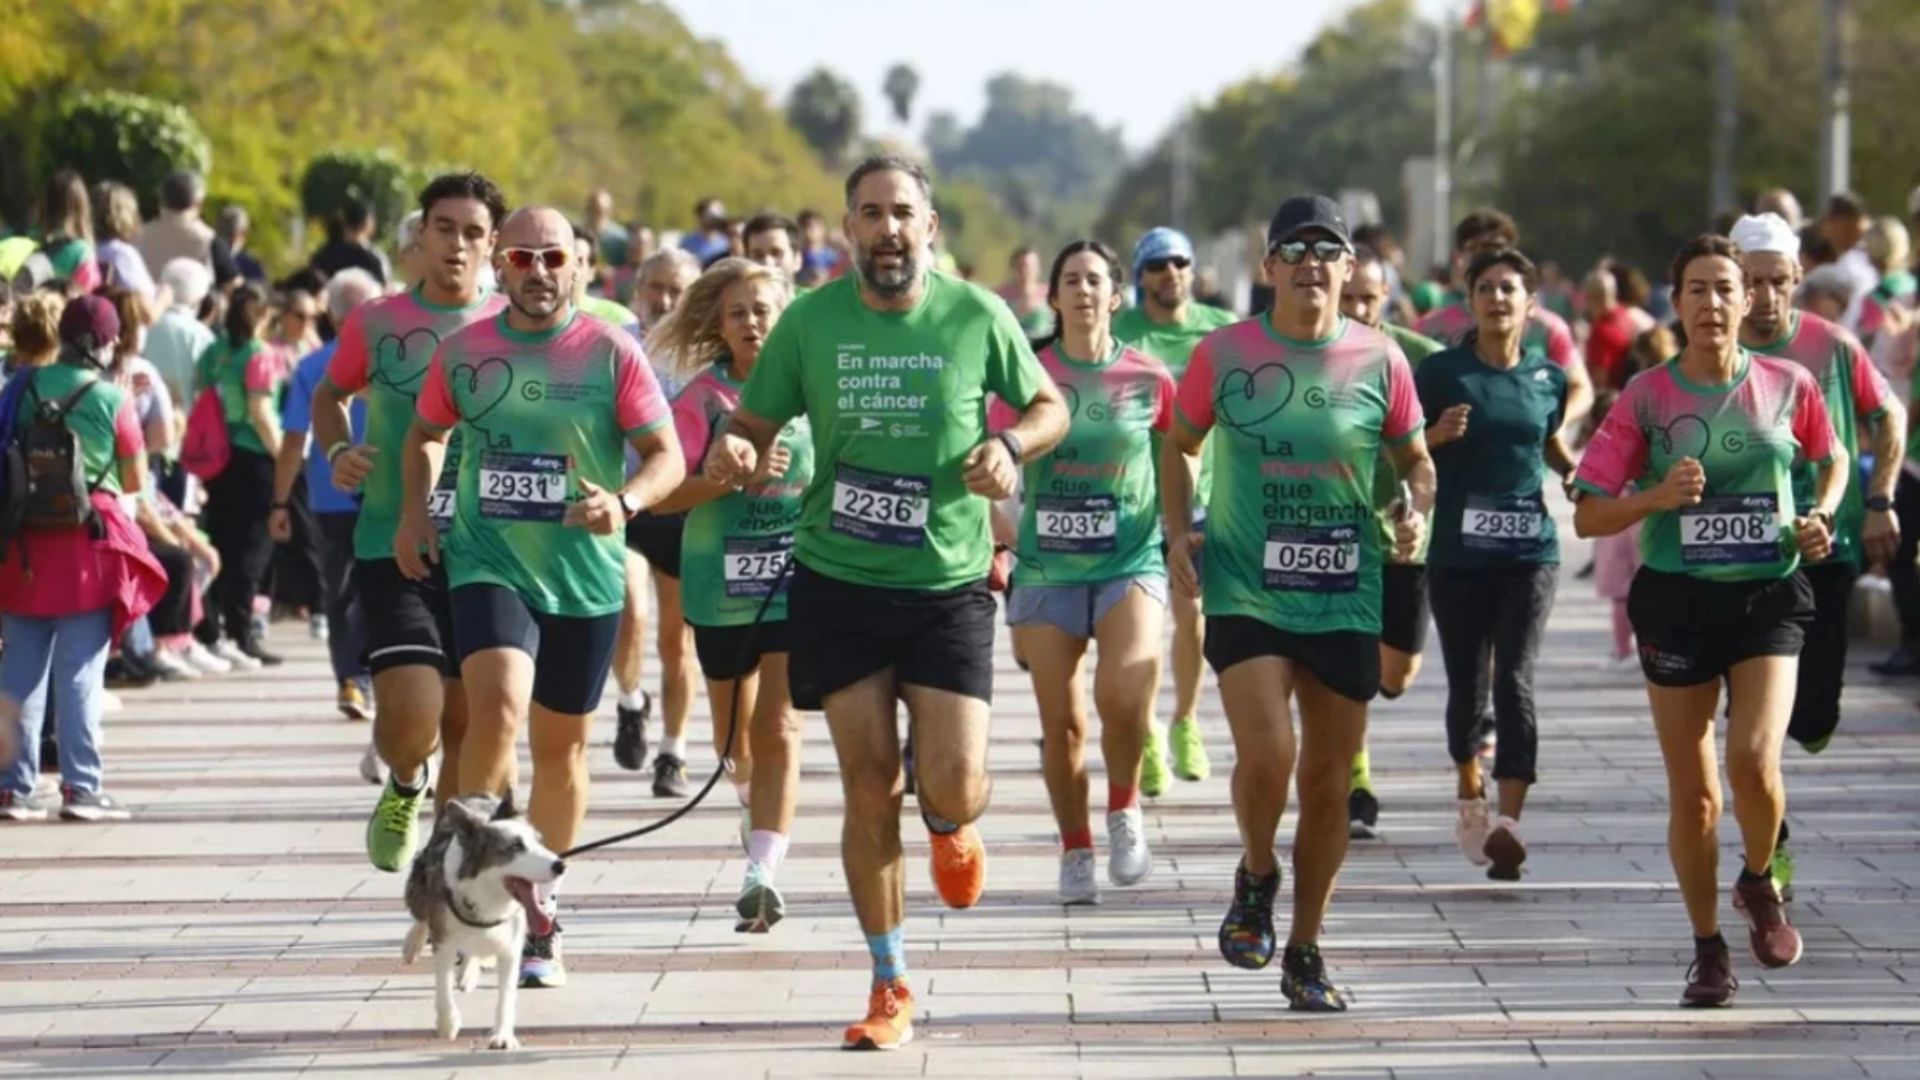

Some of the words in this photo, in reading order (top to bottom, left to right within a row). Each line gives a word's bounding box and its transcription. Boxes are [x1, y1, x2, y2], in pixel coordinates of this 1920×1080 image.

[838, 353, 863, 369] En
[869, 352, 943, 369] marcha
[838, 373, 900, 389] contra
[838, 392, 854, 409] el
[860, 391, 928, 409] cáncer
[1262, 437, 1293, 456] La
[488, 472, 548, 499] 2931
[1262, 482, 1313, 503] que
[844, 488, 912, 523] 2236
[1046, 513, 1103, 535] 2037
[1474, 512, 1530, 534] 2938
[1695, 514, 1764, 542] 2908
[1279, 545, 1347, 570] 0560
